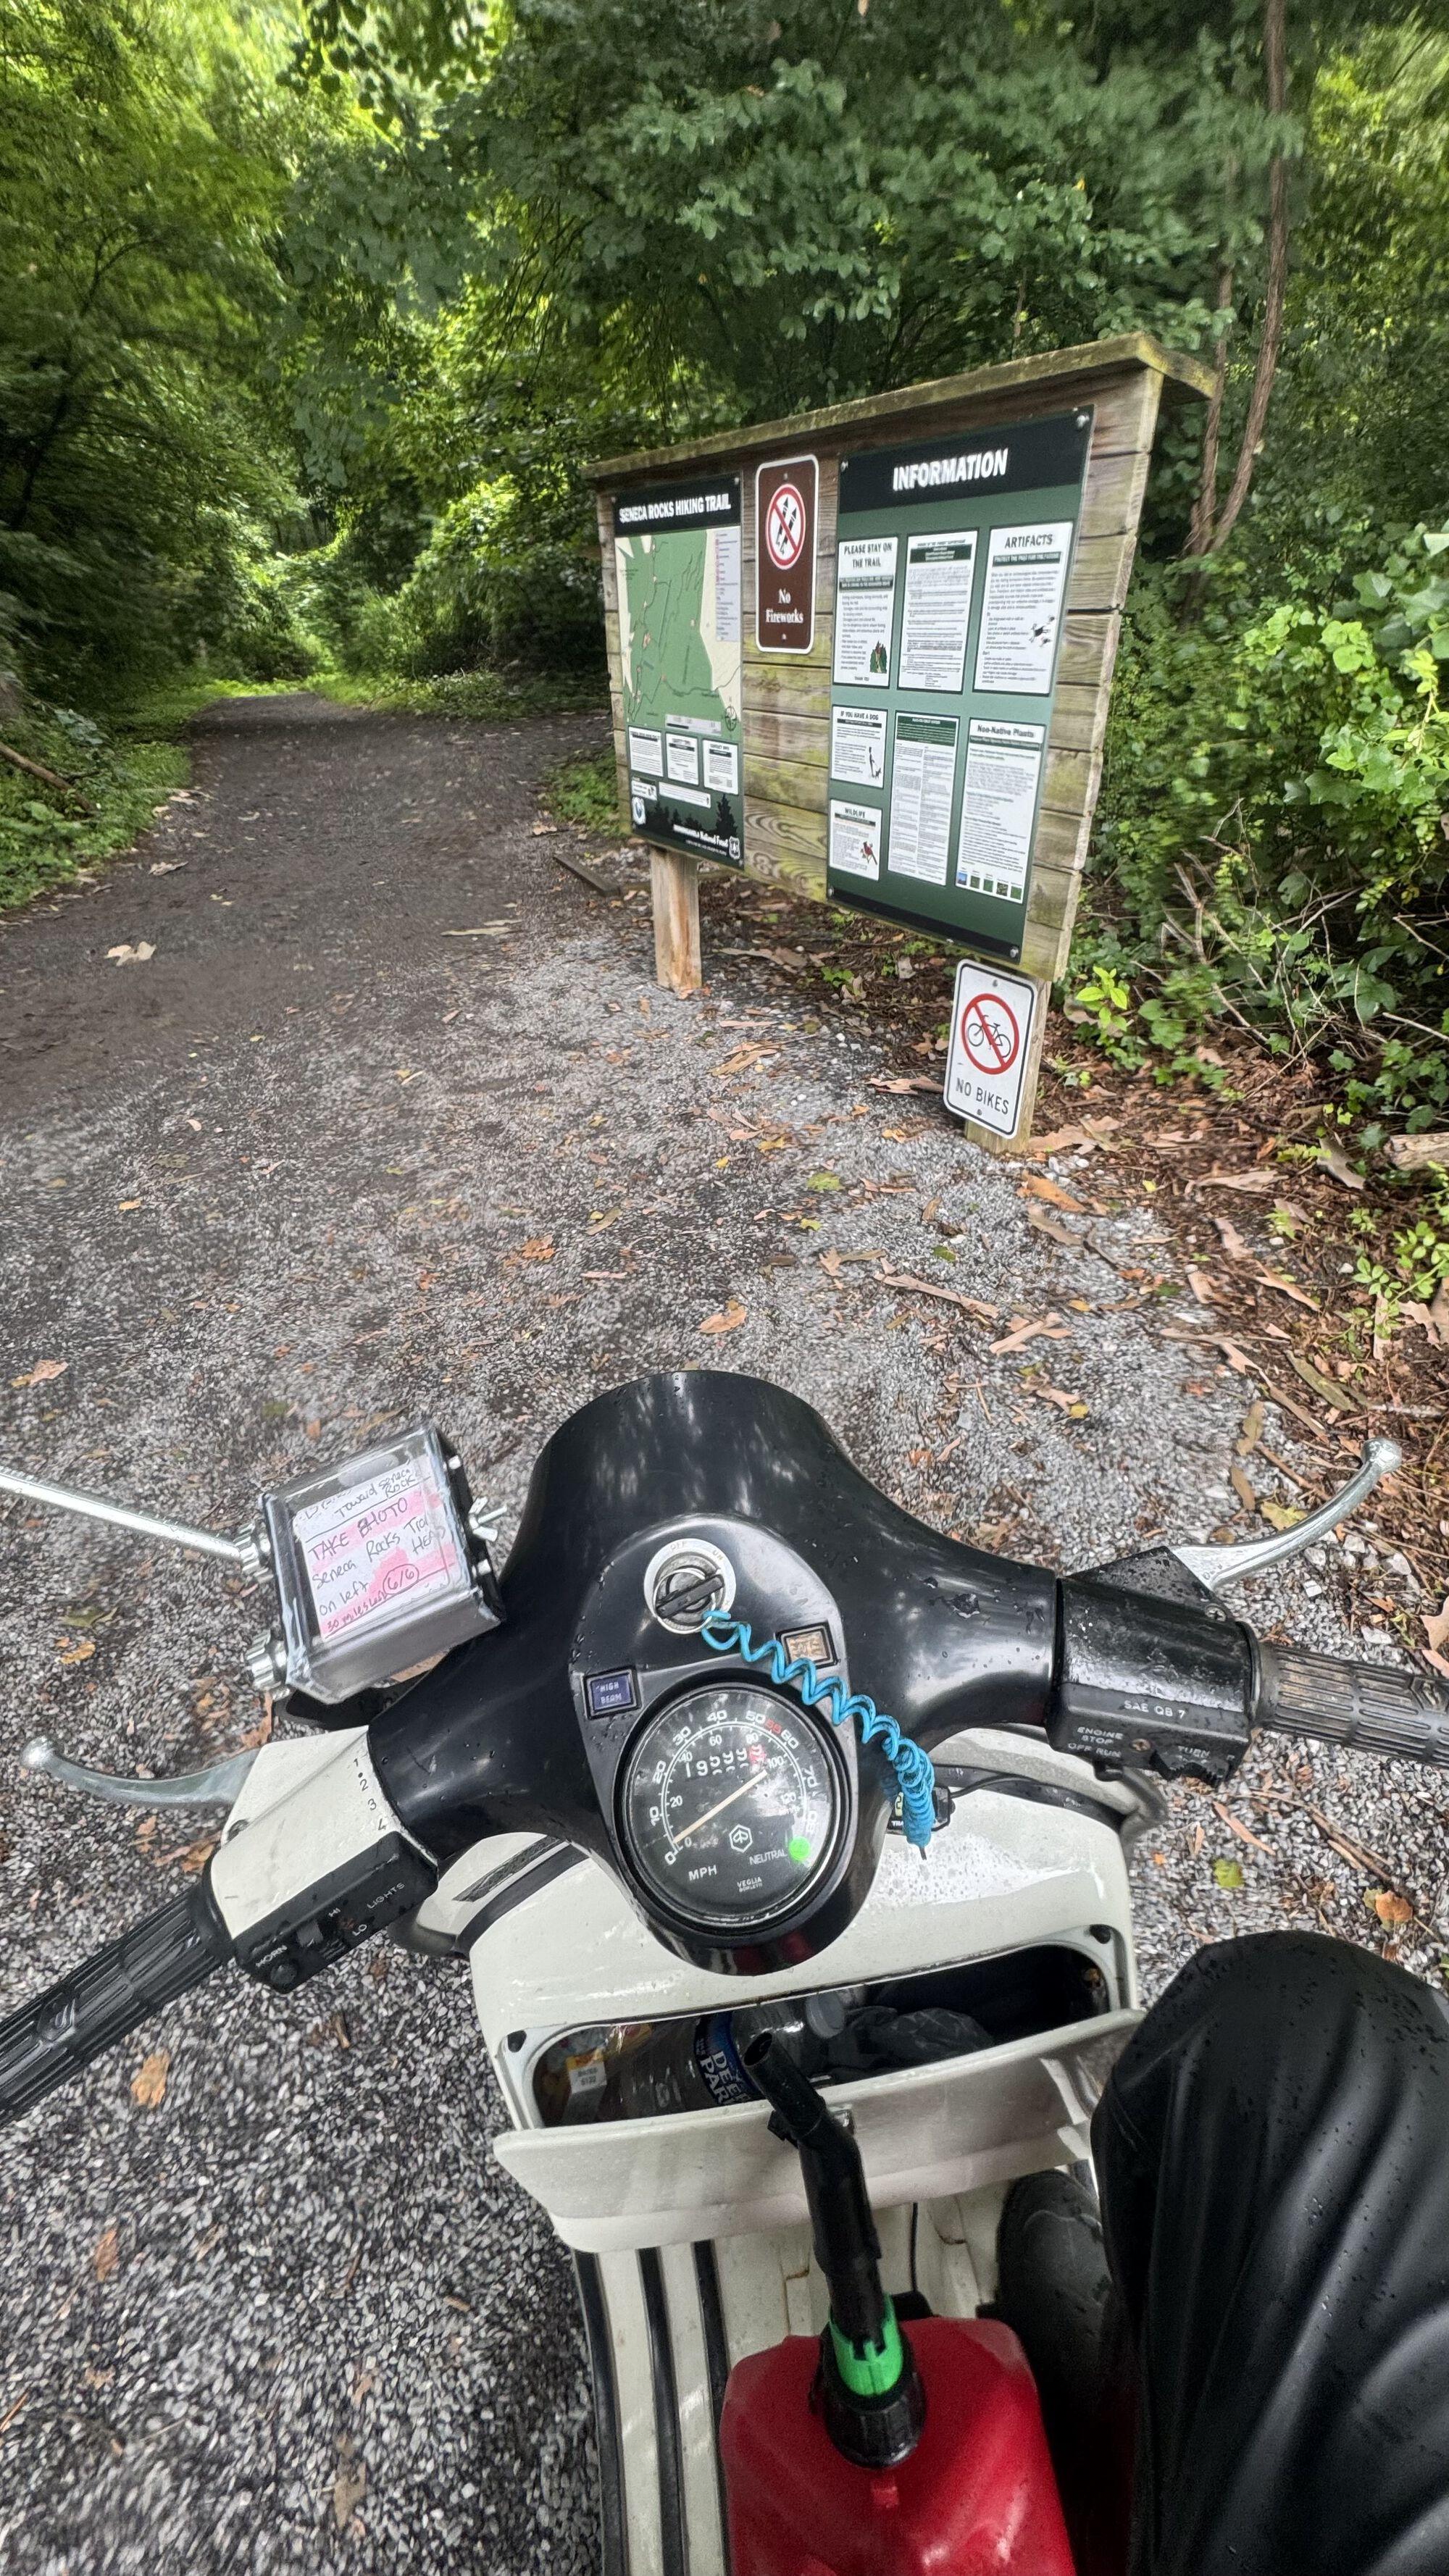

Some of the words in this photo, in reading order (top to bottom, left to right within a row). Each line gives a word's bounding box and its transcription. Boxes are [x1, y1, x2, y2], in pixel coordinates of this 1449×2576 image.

[893, 448, 1009, 492] INFORMATION
[619, 506, 648, 524] SENECA
[648, 501, 675, 519] ROCKS
[675, 497, 704, 516] HIKING
[705, 493, 732, 512] TRAIL
[844, 543, 866, 555] PLEASE
[867, 543, 882, 553] STAY
[882, 542, 893, 553] ON
[1004, 534, 1053, 549] ARTIFACTS
[853, 559, 864, 569] THE
[865, 557, 881, 568] TRAIL
[778, 588, 791, 604] No
[765, 609, 803, 624] Fireworks
[977, 724, 1011, 735] Non-Native
[1013, 728, 1035, 738] Plants
[956, 1077, 972, 1097] NO
[976, 1087, 1010, 1115] BIKES
[307, 1532, 350, 1561] TAKE
[357, 1497, 409, 1538] PHOTO
[600, 1681, 619, 1692] HIGH
[601, 1693, 622, 1705] BEAM
[706, 1710, 727, 1723] 40
[1124, 1700, 1149, 1713] SAE
[1179, 1709, 1186, 1719] 7
[745, 1710, 766, 1724] 50
[672, 1726, 691, 1746] 30
[746, 1732, 759, 1744] 80
[781, 1730, 800, 1749] 60
[1077, 1726, 1124, 1739] ENGINE
[709, 1734, 722, 1747] 60
[1081, 1735, 1114, 1746] STOP
[678, 1751, 693, 1763] 40
[1068, 1742, 1093, 1752] OFF
[1095, 1747, 1122, 1758] RUN
[1177, 1745, 1211, 1758] TURN
[353, 1758, 359, 1767] 1
[767, 1756, 785, 1769] 100
[653, 1760, 667, 1784] 20
[803, 1765, 819, 1788] 70
[360, 1779, 369, 1791] 2
[367, 1798, 377, 1810] 3
[669, 1795, 683, 1808] 20
[649, 1806, 660, 1826] 10
[378, 1818, 387, 1831] 4
[684, 1836, 693, 1848] 0
[664, 1852, 677, 1865] 0
[749, 1848, 788, 1865] NEUTRAL
[688, 1865, 717, 1881] MPH
[737, 1876, 763, 1889] VEGLIA
[367, 1882, 406, 1910] LIGHTS
[328, 1907, 341, 1918] HI
[352, 1923, 367, 1937] LO
[255, 1944, 288, 1968] HORN
[699, 2055, 736, 2104] PAR
